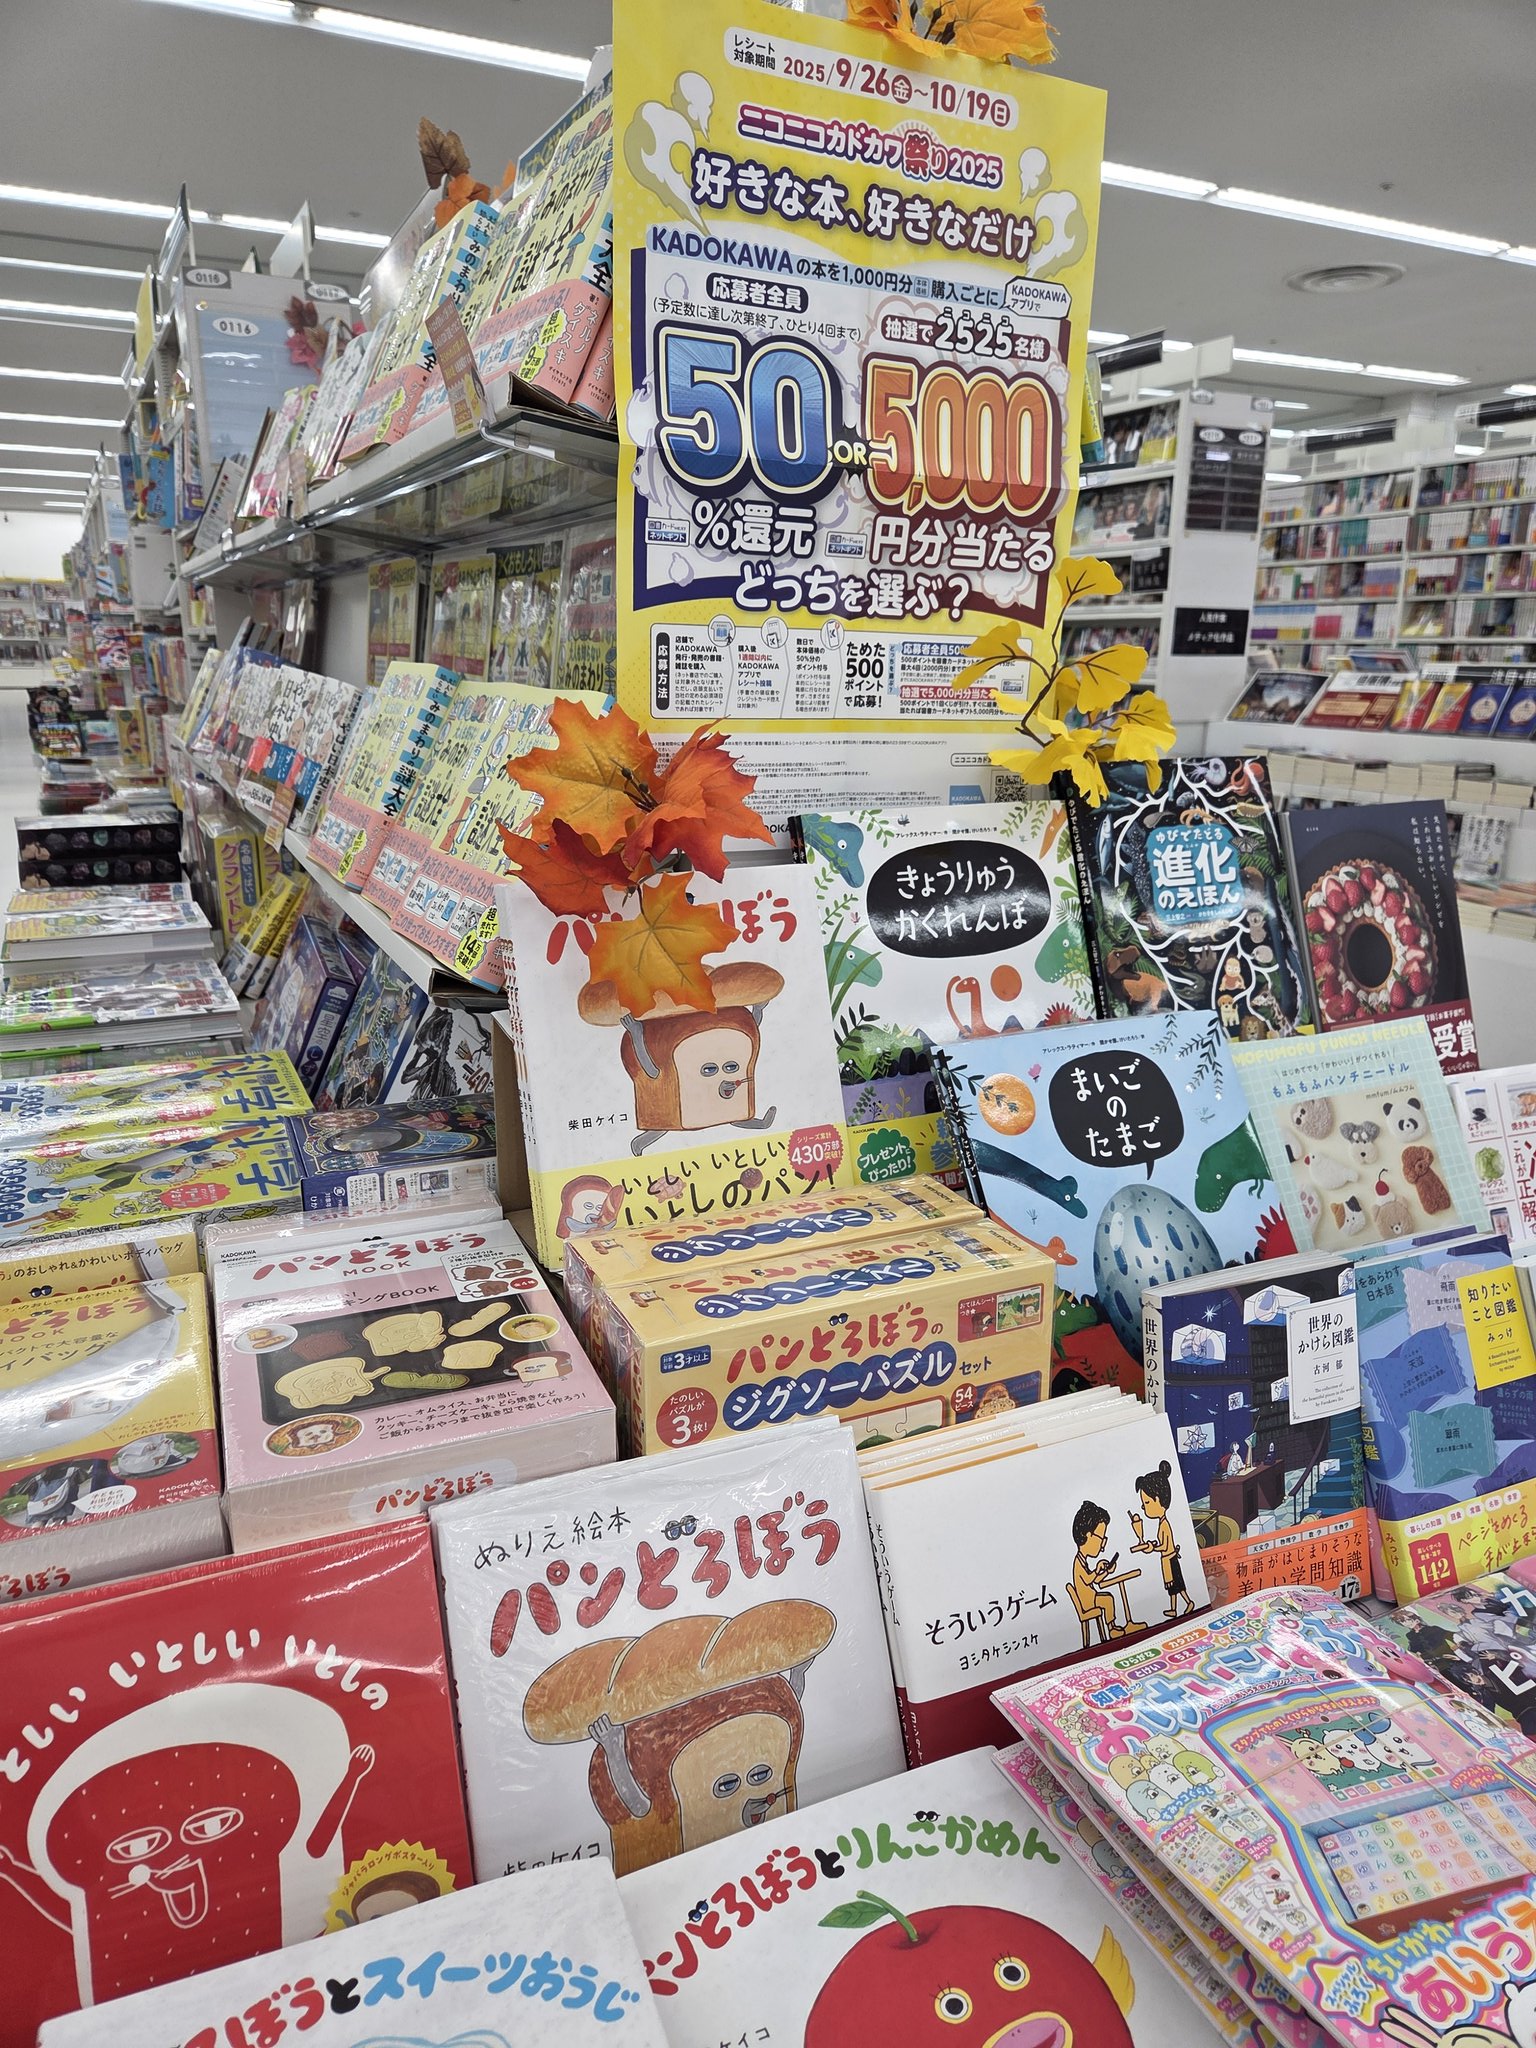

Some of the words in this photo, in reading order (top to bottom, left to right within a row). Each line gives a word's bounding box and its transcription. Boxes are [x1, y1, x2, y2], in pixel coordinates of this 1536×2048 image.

[734, 35, 775, 53] レシート
[733, 49, 776, 70] 対象期間
[738, 104, 1004, 189] ニコニコカドカワ祭り2025
[692, 151, 1037, 263] 好きな本、好きなだけ
[711, 276, 802, 311] 応募者全員
[931, 280, 1000, 307] 購入ごとに
[1011, 284, 1067, 305] KADOKAWA
[1011, 299, 1041, 314] アプリで
[218, 321, 252, 334] 0116
[661, 326, 836, 493] 50
[835, 444, 867, 468] OR
[866, 358, 1057, 516] 5,000
[650, 532, 685, 542] ネットギフト
[693, 500, 815, 557] %還元
[830, 545, 862, 554] ネットギフト
[871, 516, 1054, 573] 円分当たる
[734, 561, 970, 620] どっちを選ぶ?
[675, 636, 694, 644] 店舗で
[847, 642, 885, 657] ためた
[658, 645, 668, 699] 応募方法
[675, 662, 706, 670] 雑誌を購入
[846, 659, 883, 678] 500
[845, 680, 883, 692] ポイント
[844, 695, 882, 708] で応募!
[897, 857, 1015, 899] きょうりゅう
[1154, 841, 1236, 889] 進化
[1158, 886, 1240, 909] のえほん
[896, 895, 1027, 941] かくれんぼ
[1320, 1035, 1368, 1055] PUNCH
[1374, 1021, 1425, 1042] NEEDLE
[1432, 1019, 1477, 1061] 受賞
[1070, 1058, 1142, 1102] まいご
[1272, 1062, 1409, 1098] もふもふパンチニードル
[1107, 1096, 1127, 1118] の
[568, 1112, 628, 1131] 柴田ケイコ
[1085, 1115, 1161, 1158] たまご
[791, 1140, 824, 1164] 430
[824, 1139, 840, 1151] 万部
[860, 1143, 910, 1168] プレゼントに
[623, 1161, 700, 1195] いとしい
[711, 1139, 785, 1170] いとしい
[220, 1249, 257, 1259] KADOKAWA
[253, 1232, 487, 1281] パンどろぼう
[342, 1261, 410, 1277] MOOK
[960, 1297, 995, 1309] おてほんシート
[1366, 1283, 1394, 1302] 日本語
[1468, 1280, 1512, 1302] 知りたい
[1308, 1313, 1343, 1334] 世界の
[1472, 1299, 1517, 1322] こと図鑑
[727, 1301, 943, 1383] パンどろぼうの
[1298, 1327, 1354, 1354] かけら図鑑
[1487, 1328, 1513, 1343] みっけ
[674, 1353, 709, 1369] 3才以上
[959, 1357, 992, 1376] セット
[1313, 1363, 1330, 1375] 古河
[670, 1392, 704, 1405] たのしい
[731, 1351, 951, 1427] ジグソーパズル
[955, 1386, 973, 1402] 54
[374, 1390, 518, 1426] カレー、オムライス、お弁当に
[375, 1390, 556, 1432] クッキー、チーズケーキ、どら焼きなど
[378, 1393, 588, 1441] ご飯からおやつまで抜き型で楽しく作ろう!
[669, 1401, 705, 1416] パズルが
[955, 1401, 974, 1411] ピース
[375, 1471, 494, 1514] パンどろぼう
[473, 1506, 632, 1570] ぬりえ絵本
[1280, 1535, 1296, 1545] 物理学
[1458, 1504, 1527, 1551] ページをめくる
[1236, 1532, 1362, 1579] 物語がはじまりそうな
[1385, 1532, 1399, 1567] みっけ
[489, 1491, 841, 1659] パンどろぼう
[1418, 1557, 1450, 1585] 142
[1340, 1580, 1354, 1598] 17
[924, 1585, 1057, 1645] そういうゲーム
[959, 1633, 1040, 1671] ヨシタケシンスケ
[1119, 1650, 1155, 1667] ひらがな
[1168, 1632, 1200, 1648] カタカナ
[108, 1628, 262, 1689] いとしい
[283, 1634, 390, 1712] いとしの
[1134, 1663, 1161, 1678] とけい
[1174, 1651, 1191, 1662] ちえ
[1091, 1686, 1131, 1708] 知育
[1366, 1920, 1455, 1980] ちいかわ
